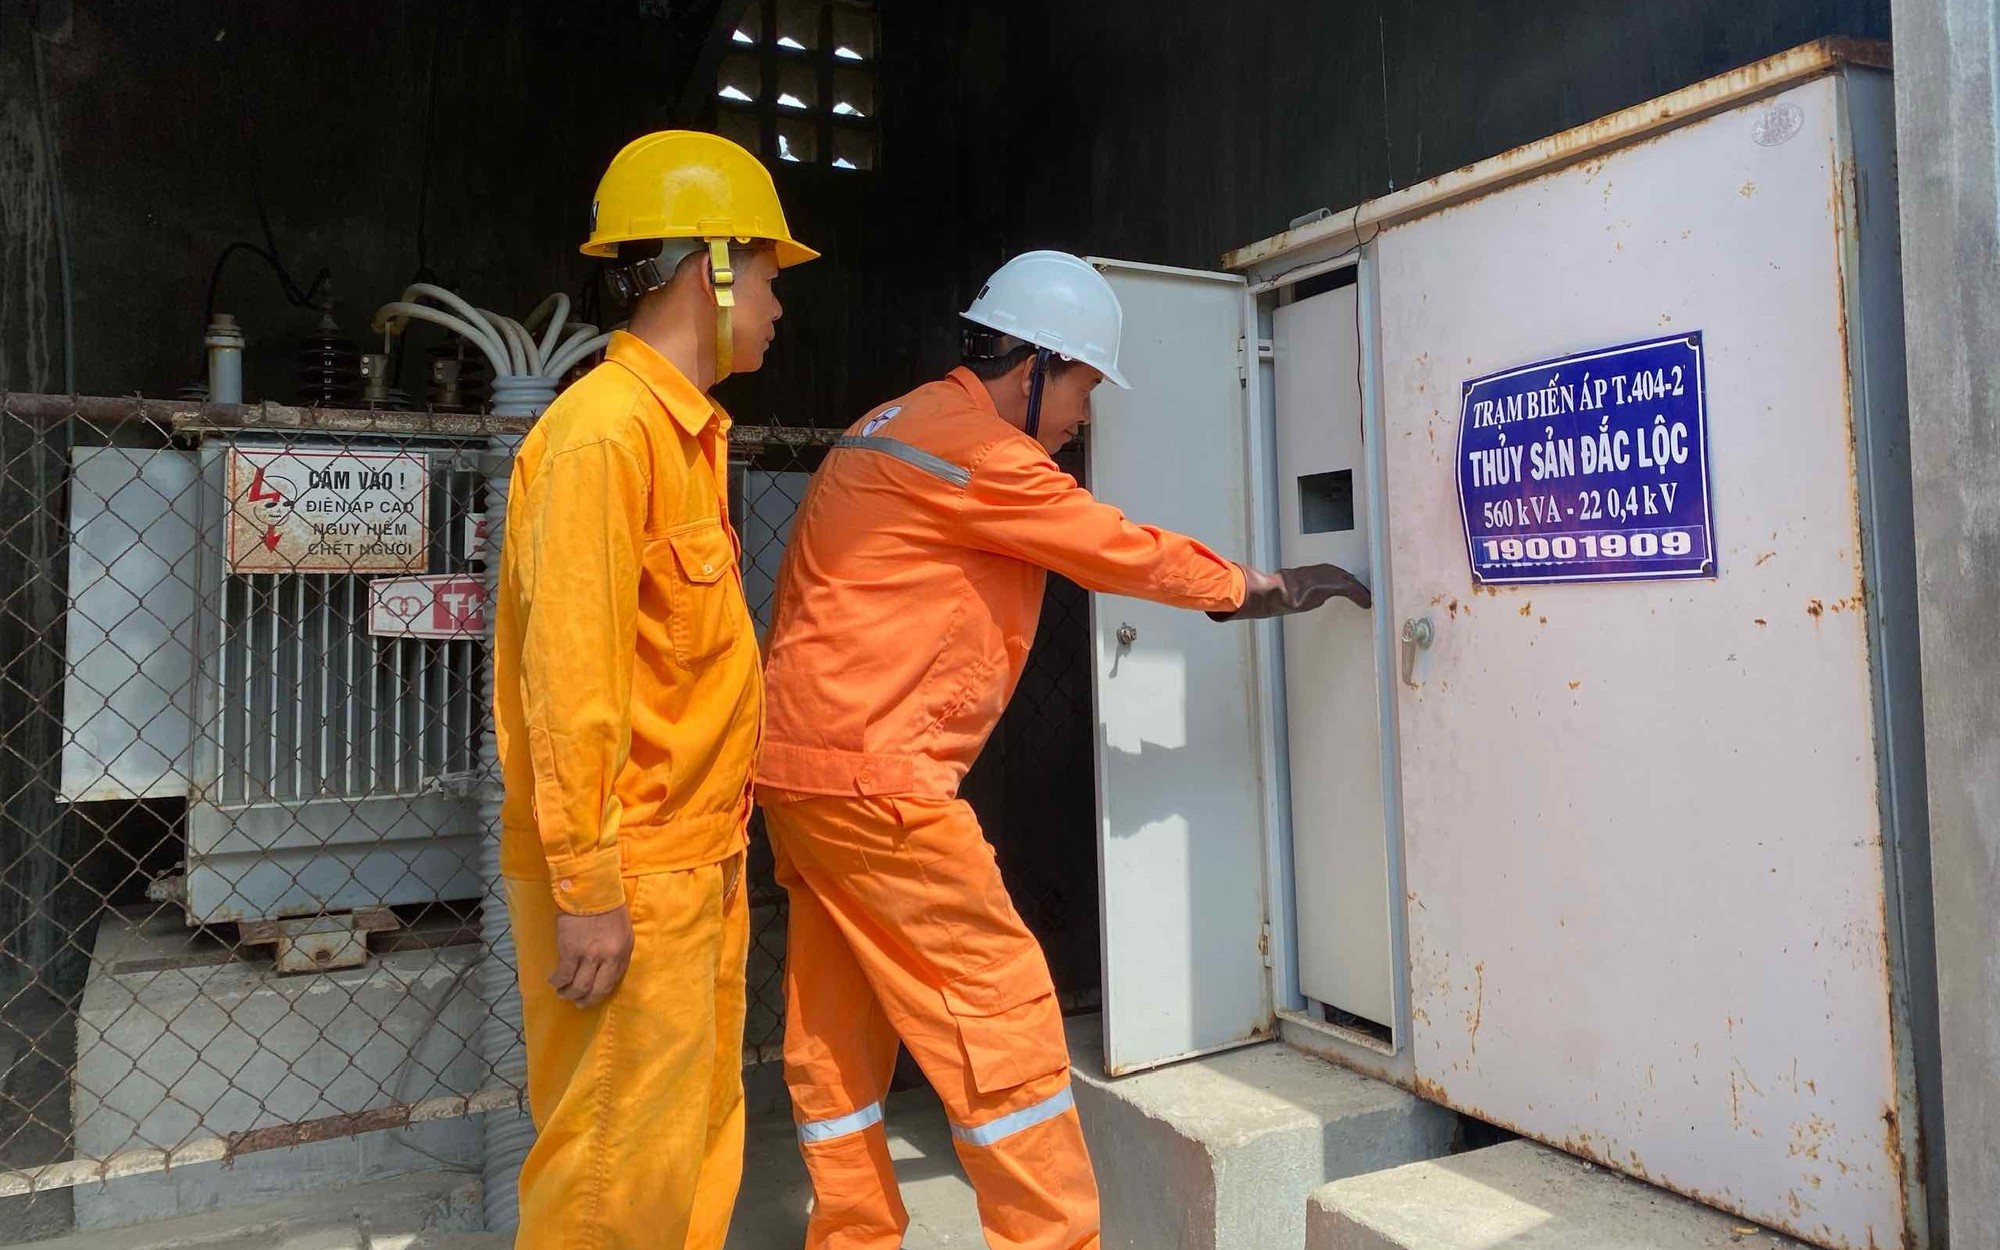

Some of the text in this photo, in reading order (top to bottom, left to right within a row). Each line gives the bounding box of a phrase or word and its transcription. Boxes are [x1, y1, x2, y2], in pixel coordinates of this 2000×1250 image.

[1473, 365, 1685, 430] TRẠM BIẾN ÁP T.404-2
[1469, 414, 1688, 487] THỦY SẢN ĐẮC LỘC
[309, 462, 350, 490] CẤM
[358, 466, 393, 490] VÀO
[306, 497, 346, 515] ĐIỆN
[380, 501, 414, 513] CAO
[1484, 499, 1513, 528] 560
[1517, 495, 1562, 524] kVA
[1578, 490, 1602, 520] 22
[313, 516, 408, 536] NGUY HIỂM
[308, 538, 412, 555] CHẾT NGƯỜI
[1483, 531, 1691, 561] 19001909
